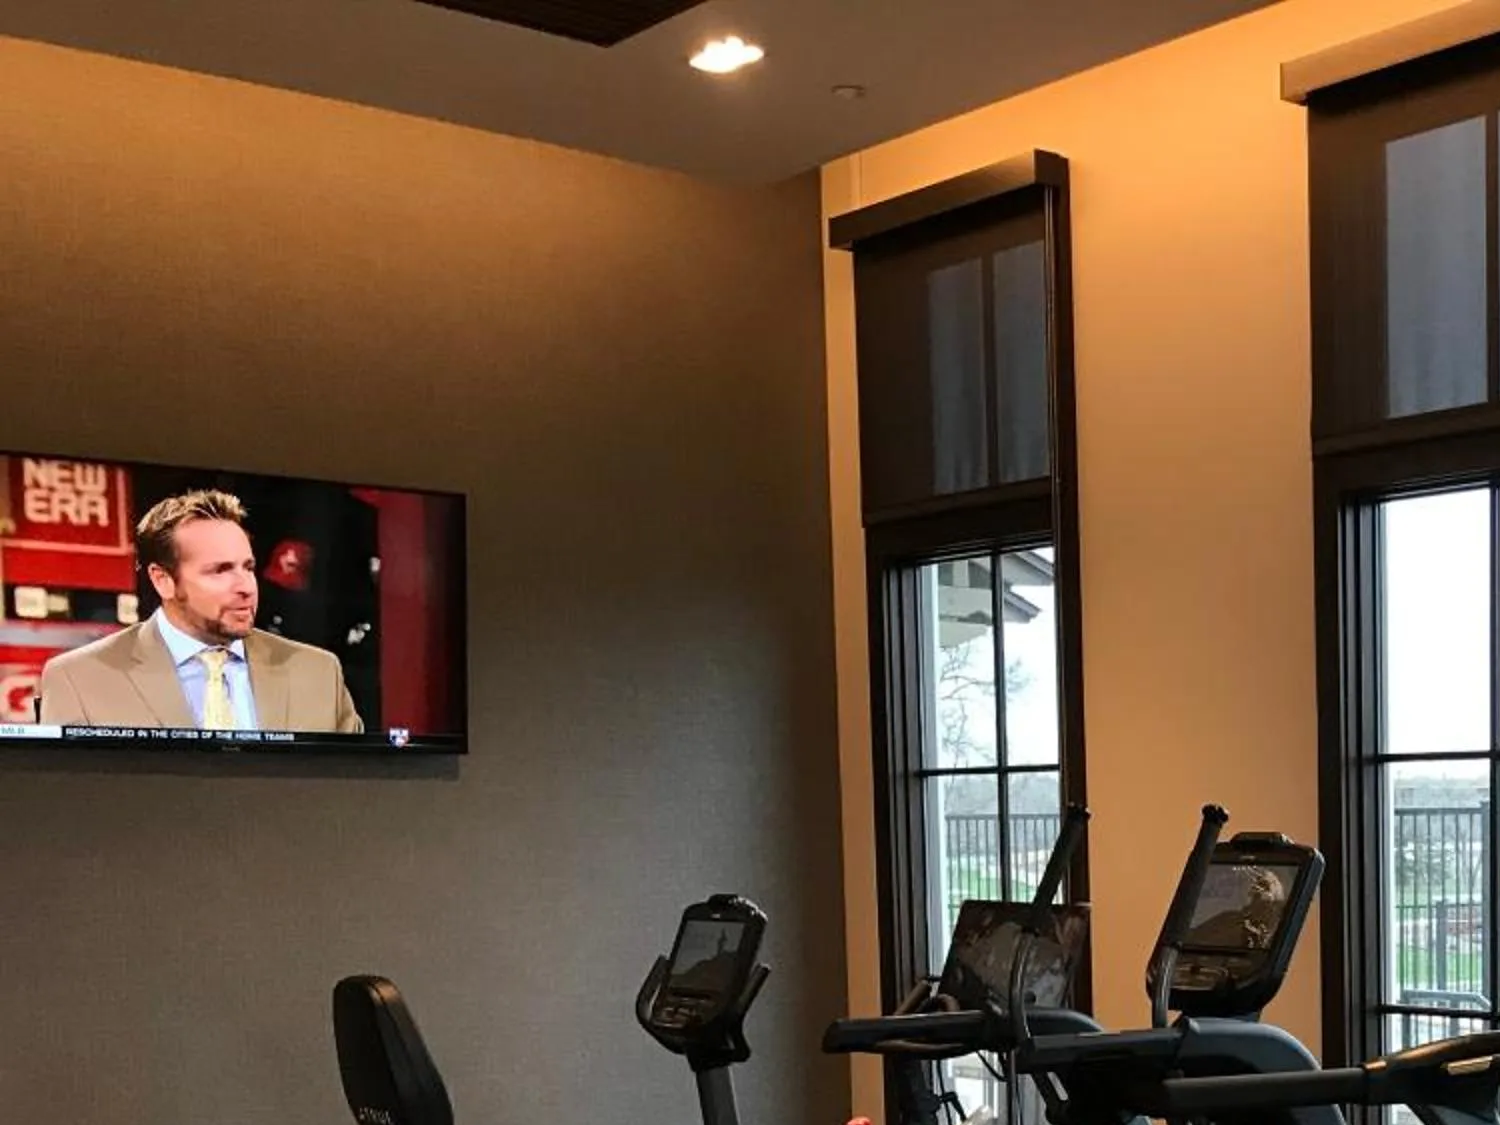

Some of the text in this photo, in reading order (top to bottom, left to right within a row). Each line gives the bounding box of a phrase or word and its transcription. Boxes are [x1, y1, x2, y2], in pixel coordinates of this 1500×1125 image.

[23, 458, 107, 491] NEW
[24, 488, 109, 527] ERA
[65, 727, 135, 738] RESCHEDULED
[138, 730, 149, 738] IN
[151, 730, 168, 739] THE
[201, 731, 213, 739] OF
